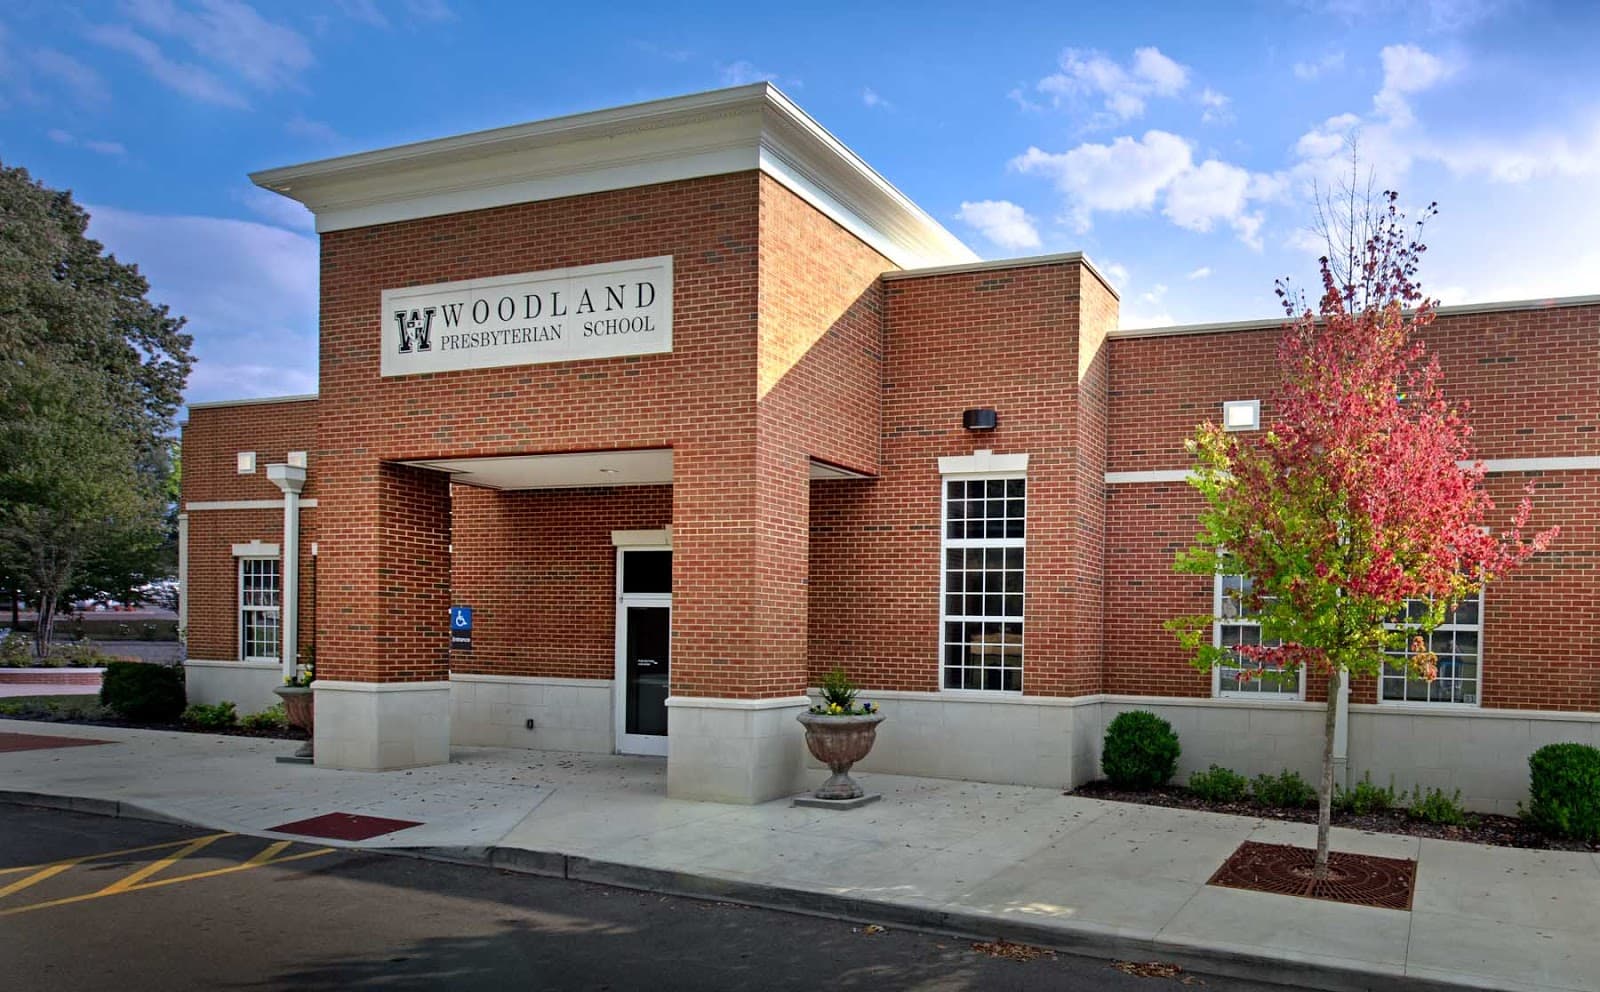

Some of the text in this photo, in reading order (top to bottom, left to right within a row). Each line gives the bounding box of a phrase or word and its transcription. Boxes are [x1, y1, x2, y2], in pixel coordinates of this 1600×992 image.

[441, 281, 656, 328] WOODLAND
[394, 307, 436, 354] W
[441, 316, 655, 351] PRESBYTERIAN SCHOOL
